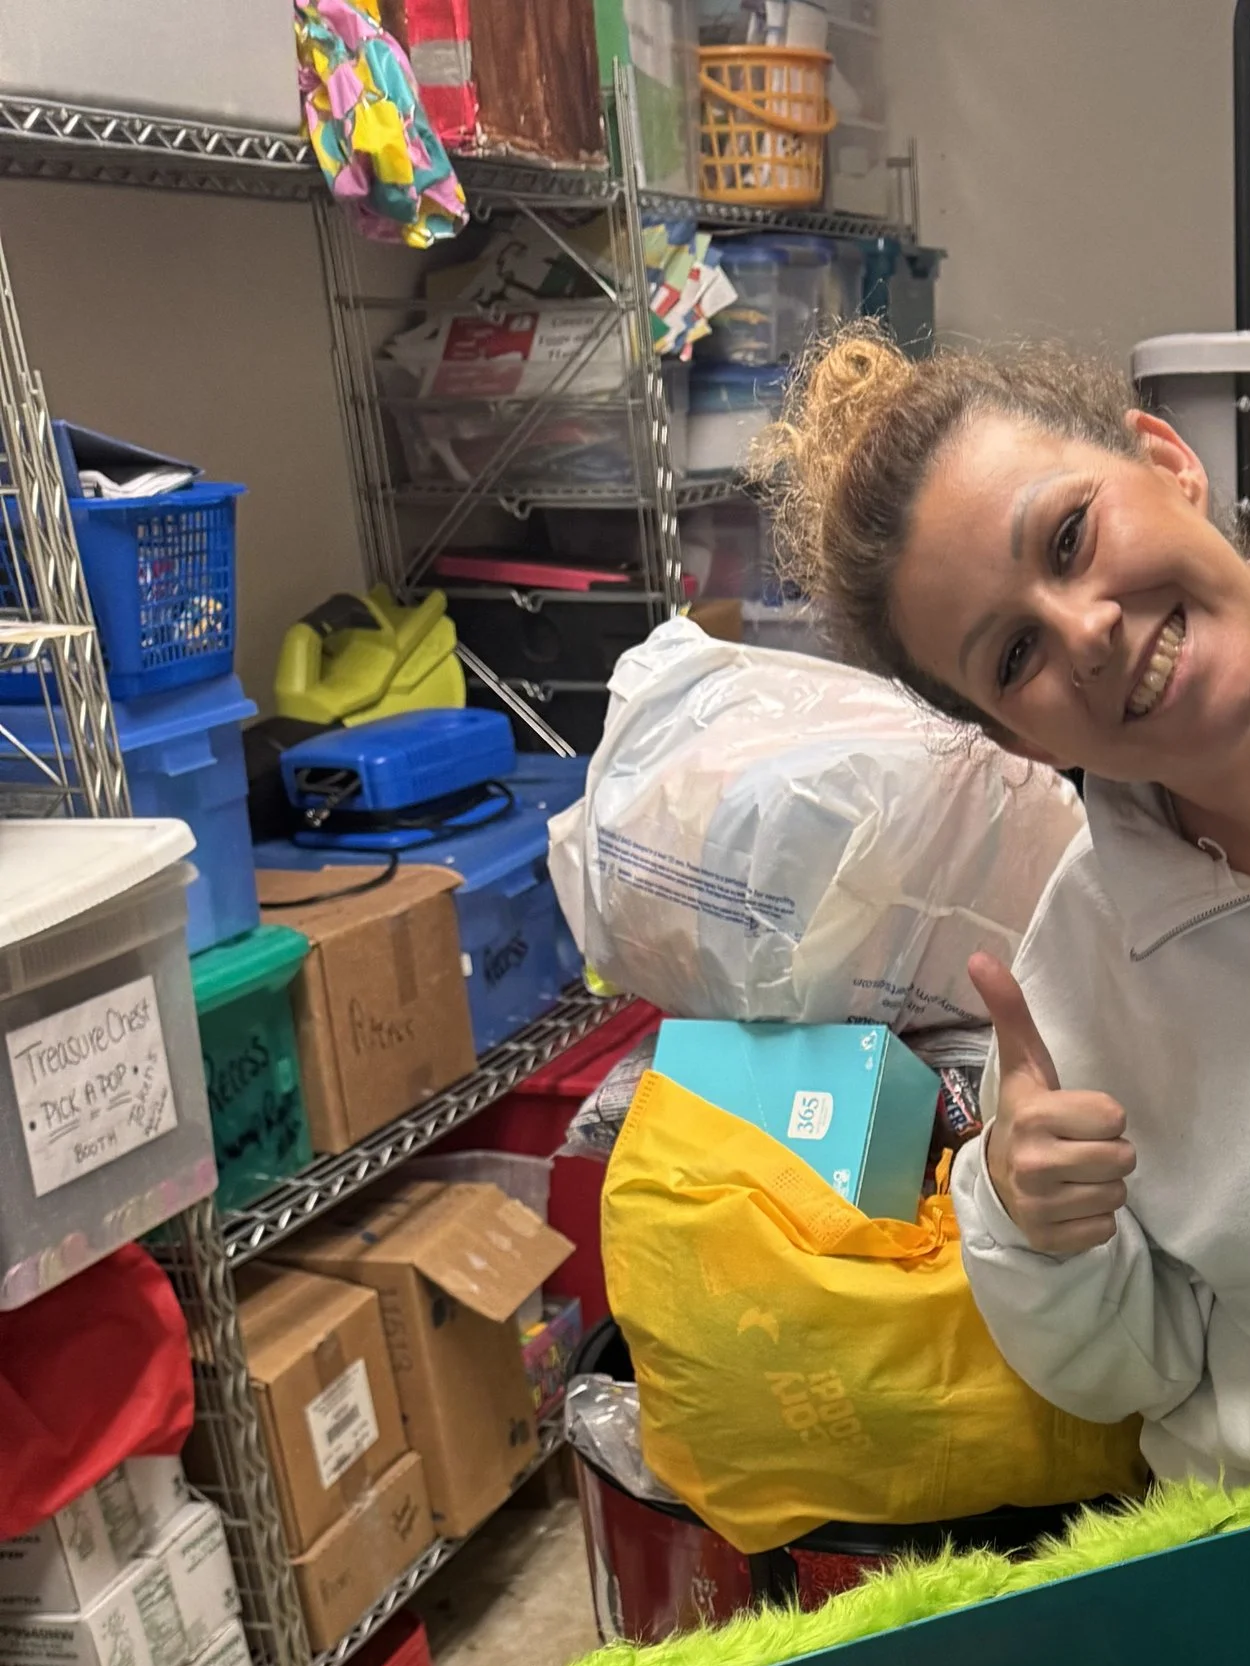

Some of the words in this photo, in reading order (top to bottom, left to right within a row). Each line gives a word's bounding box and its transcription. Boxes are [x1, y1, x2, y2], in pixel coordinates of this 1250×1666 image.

[14, 1025, 109, 1086] Treasure
[105, 996, 151, 1043] Chest
[40, 1087, 80, 1128] PICK
[84, 1079, 96, 1105] A
[96, 1062, 128, 1095] POP
[797, 1096, 820, 1135] 365
[73, 1129, 119, 1164] BOOTH
